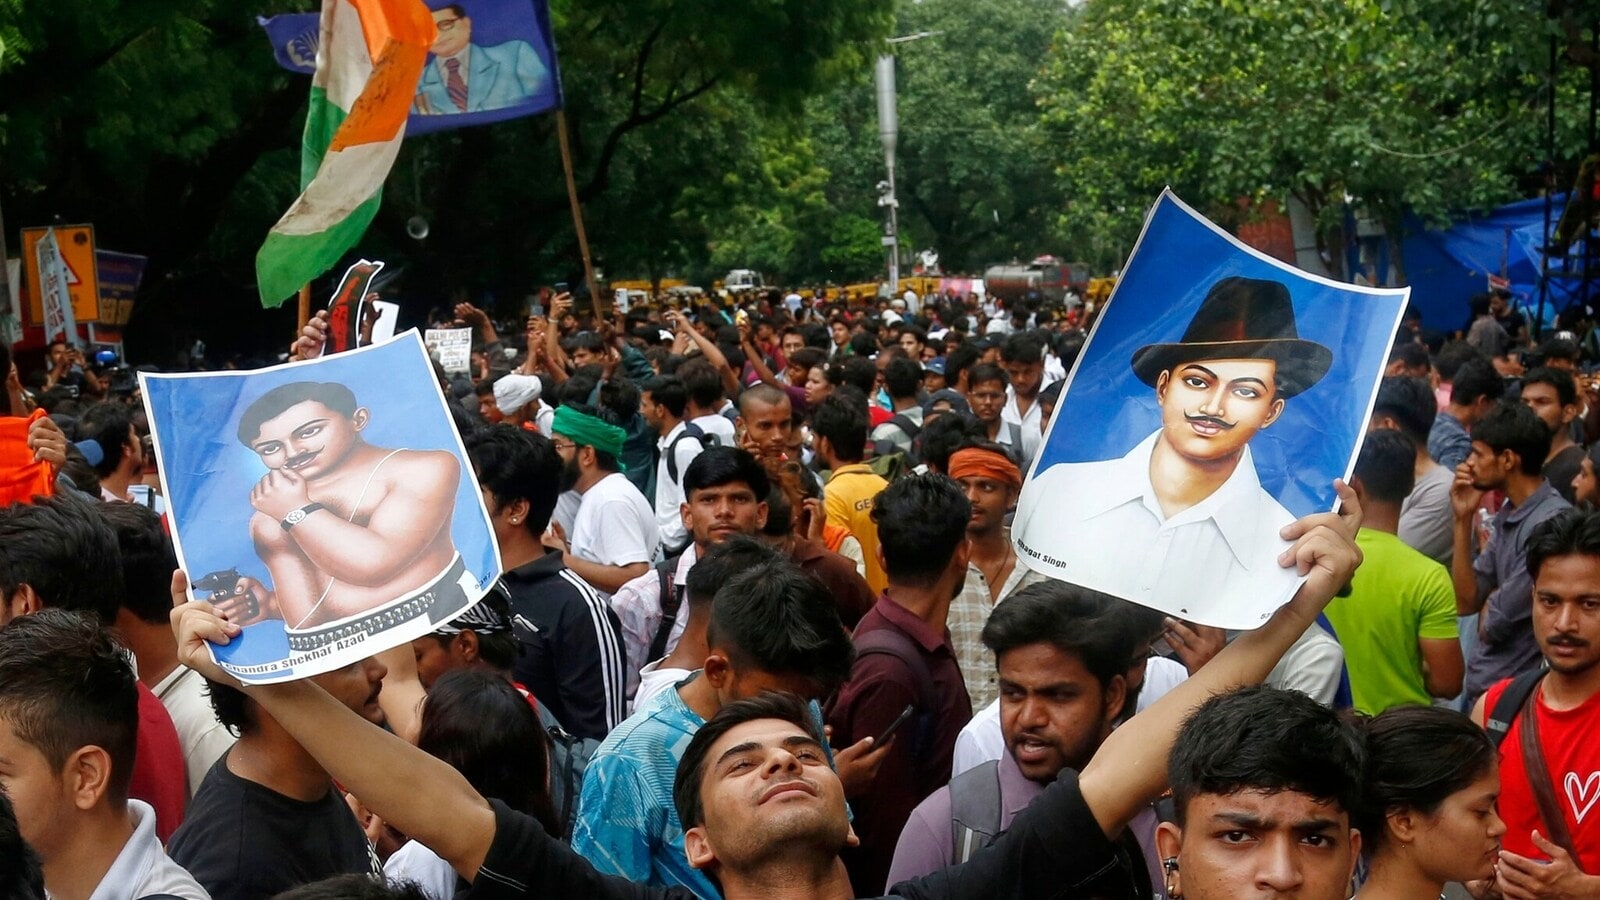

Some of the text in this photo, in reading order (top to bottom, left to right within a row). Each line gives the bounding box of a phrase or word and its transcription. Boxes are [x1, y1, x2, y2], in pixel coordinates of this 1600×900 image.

[1042, 555, 1067, 569] Singh
[281, 646, 333, 669] Shekhar
[336, 633, 365, 651] Azad
